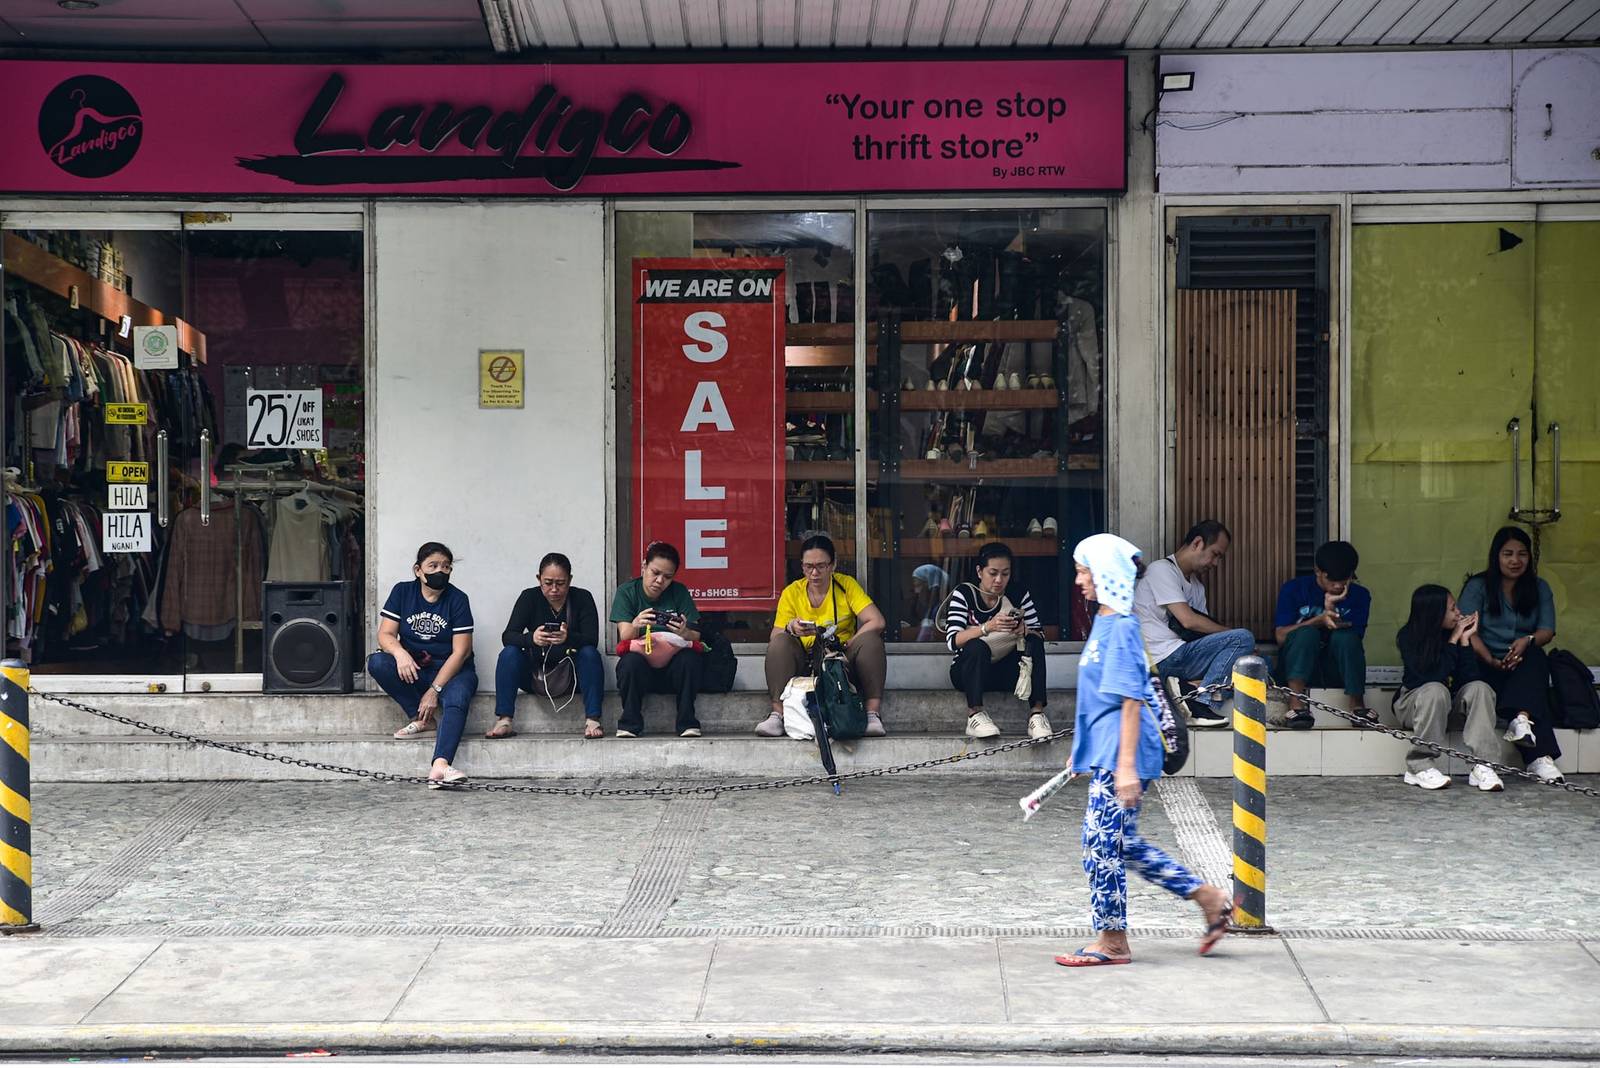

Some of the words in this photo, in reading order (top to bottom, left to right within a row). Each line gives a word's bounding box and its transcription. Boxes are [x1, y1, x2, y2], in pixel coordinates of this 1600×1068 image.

[924, 99, 983, 119] one
[996, 92, 1067, 124] stop
[852, 133, 932, 160] thrift
[993, 167, 1008, 179] By
[1011, 167, 1035, 177] JBC
[1038, 166, 1066, 176] RTW
[645, 279, 681, 297] WE
[684, 279, 734, 297] ARE
[738, 278, 772, 296] ON
[303, 402, 315, 412] OFF
[248, 394, 302, 446] 25%
[296, 429, 320, 442] SHOES
[680, 311, 735, 569] SALE
[122, 467, 145, 477] OPEN
[114, 486, 144, 506] HILA
[108, 514, 143, 538] HILA
[706, 588, 739, 597] SHOES
[411, 619, 441, 634] 1996
[431, 613, 448, 629] SOUL
